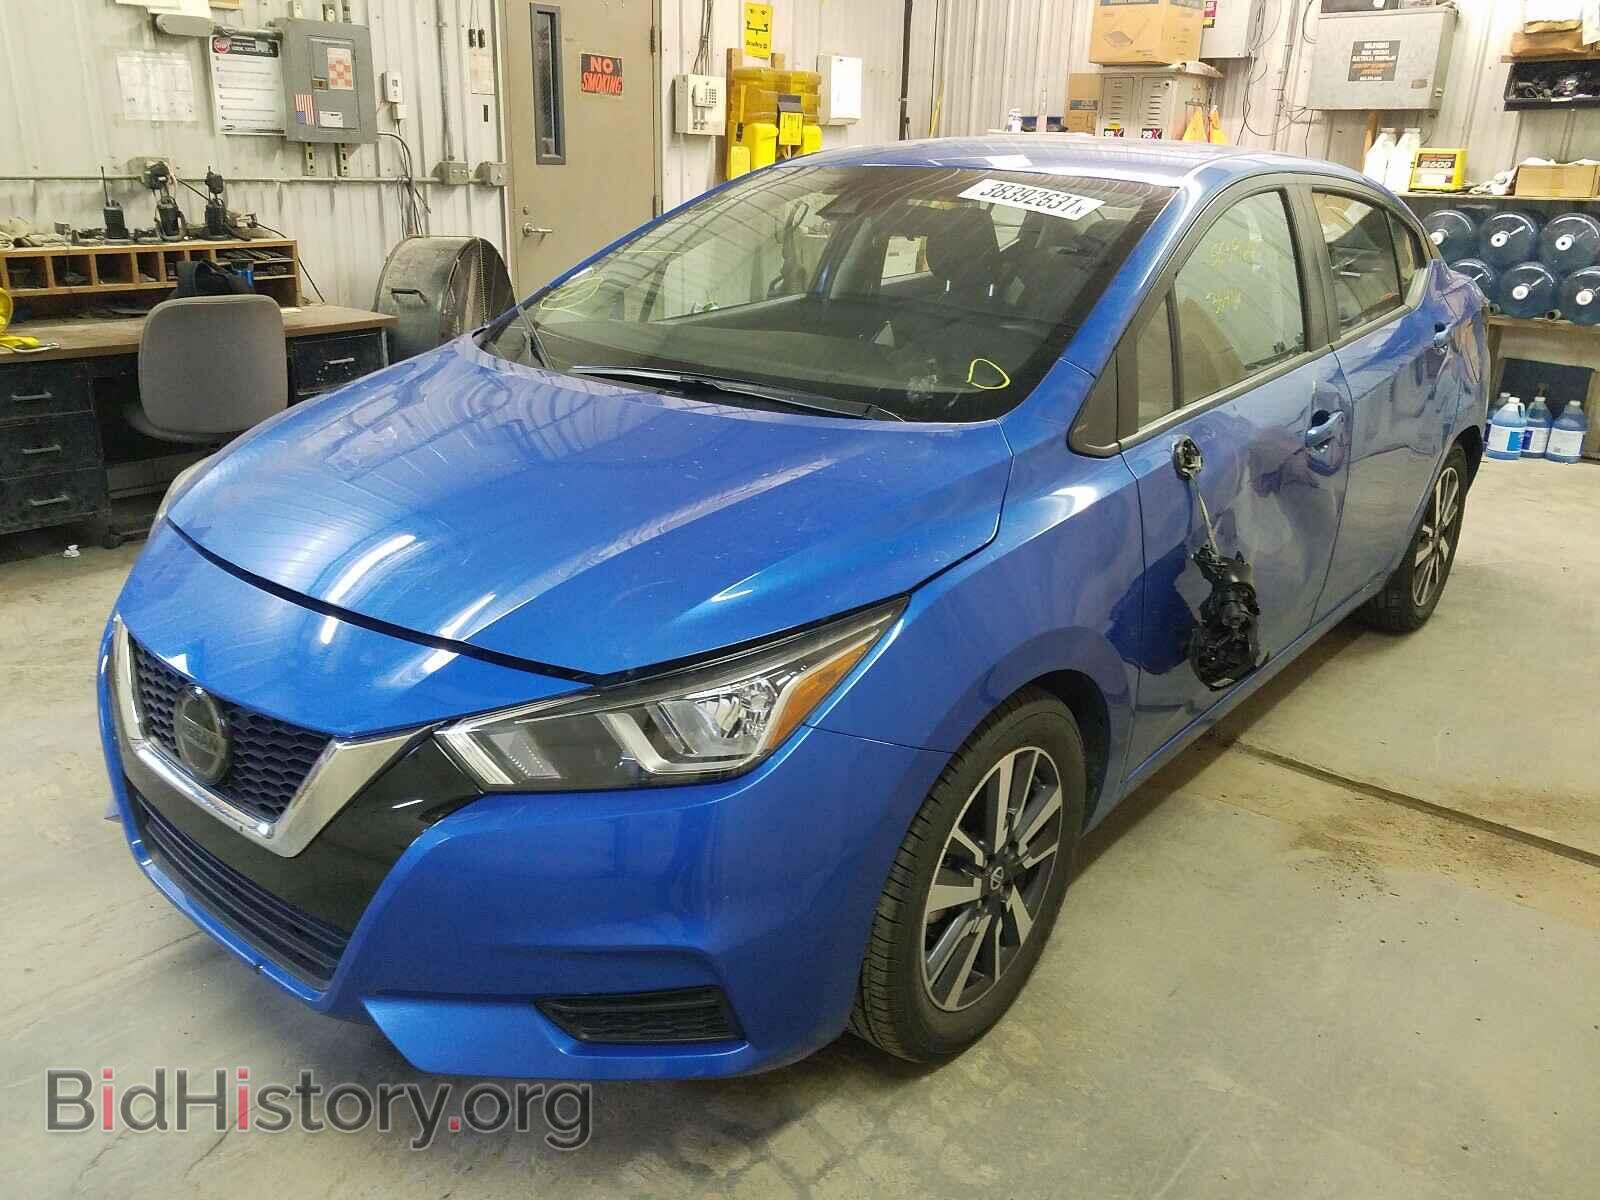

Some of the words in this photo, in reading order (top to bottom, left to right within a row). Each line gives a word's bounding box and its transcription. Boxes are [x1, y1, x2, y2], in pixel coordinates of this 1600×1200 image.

[590, 56, 613, 73] NO
[583, 72, 622, 94] SMOKING
[980, 183, 1082, 212] 38392631
